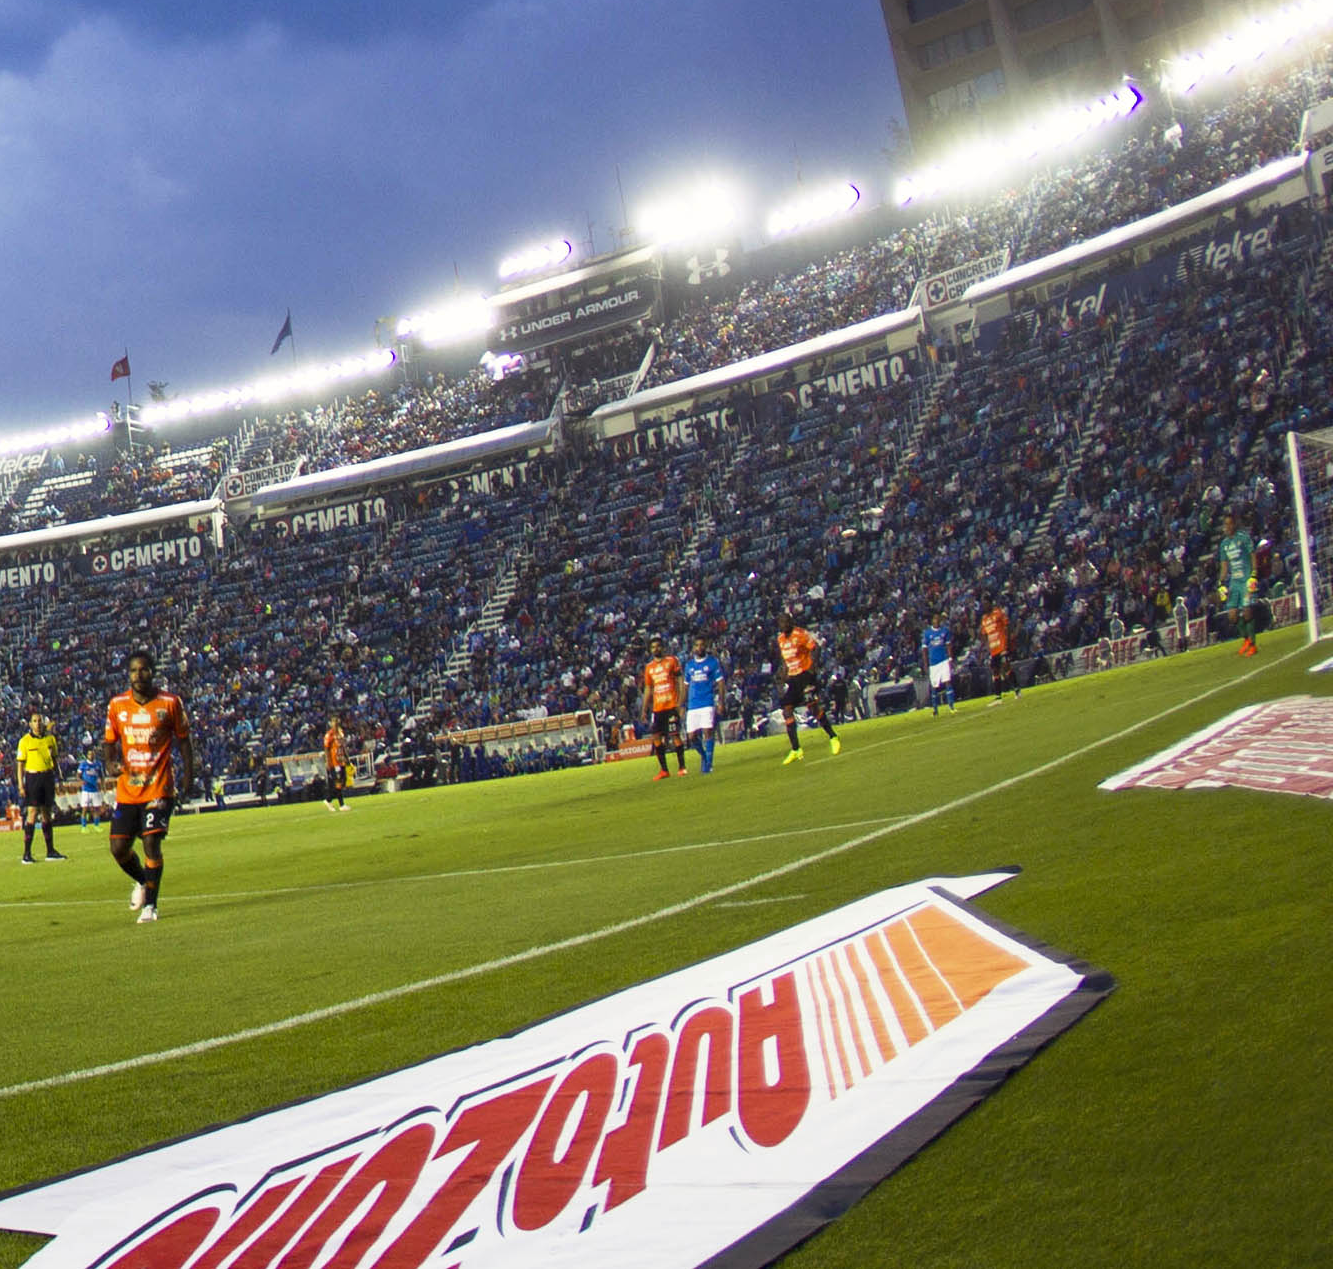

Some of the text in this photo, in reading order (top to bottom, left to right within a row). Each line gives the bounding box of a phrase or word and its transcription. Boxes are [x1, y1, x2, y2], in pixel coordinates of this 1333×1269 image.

[946, 255, 1004, 285] CONCRETOS
[520, 290, 639, 335] UNDER ARMOUR
[244, 462, 296, 484] CONCRETOS
[293, 497, 387, 533] CEMENTO
[111, 535, 202, 572] CEMENTO
